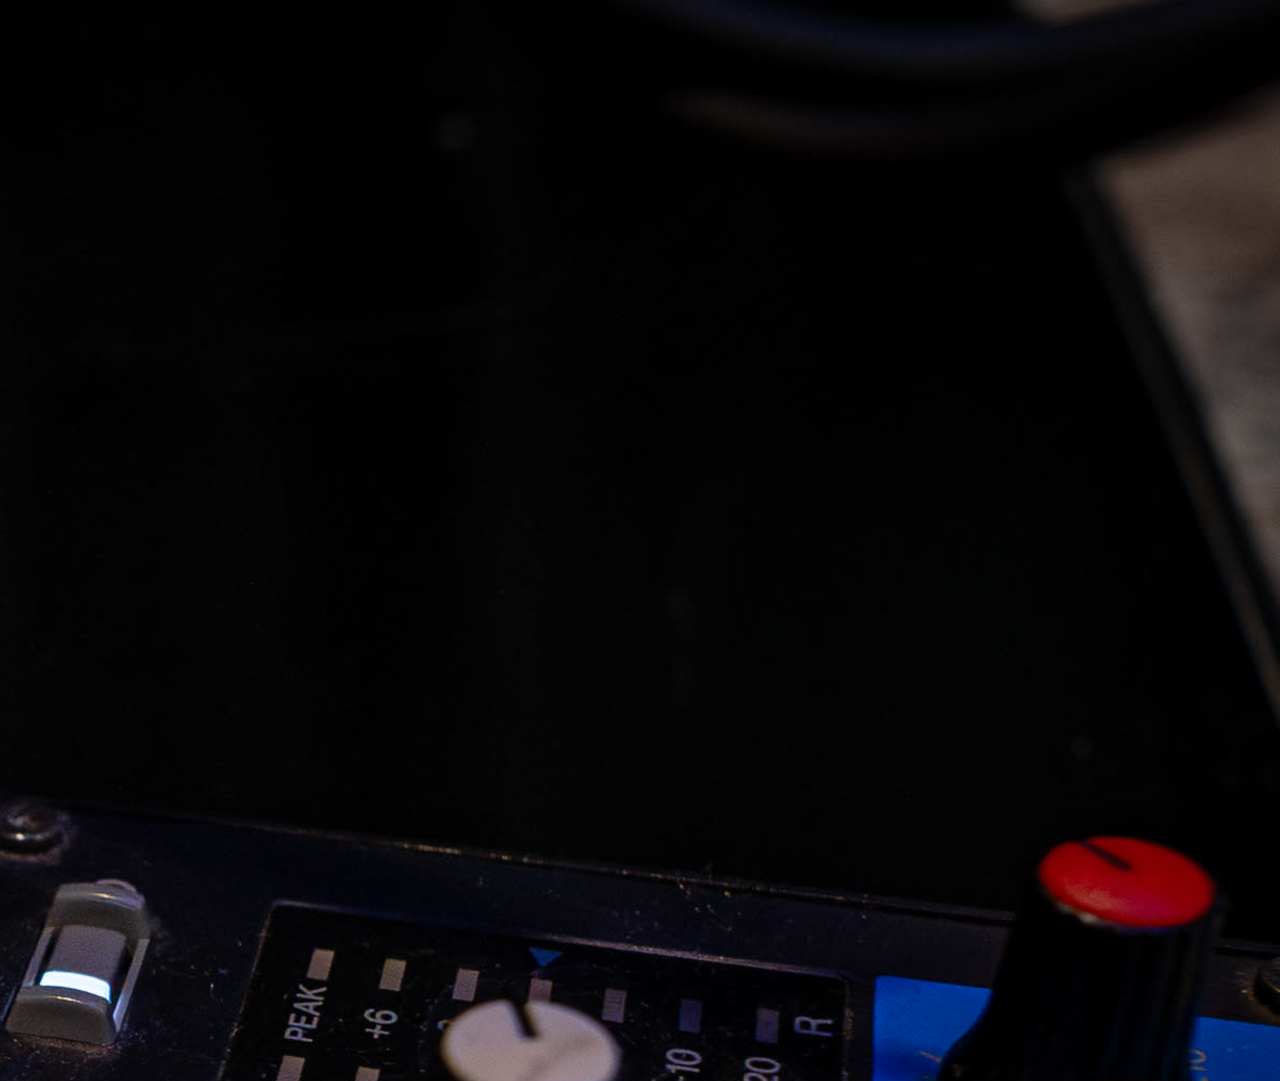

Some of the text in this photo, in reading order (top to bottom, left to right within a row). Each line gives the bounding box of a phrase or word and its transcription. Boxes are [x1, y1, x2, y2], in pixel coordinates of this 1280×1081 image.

[284, 983, 328, 1043] PEAK
[364, 1007, 400, 1041] +6
[792, 1013, 836, 1039] R
